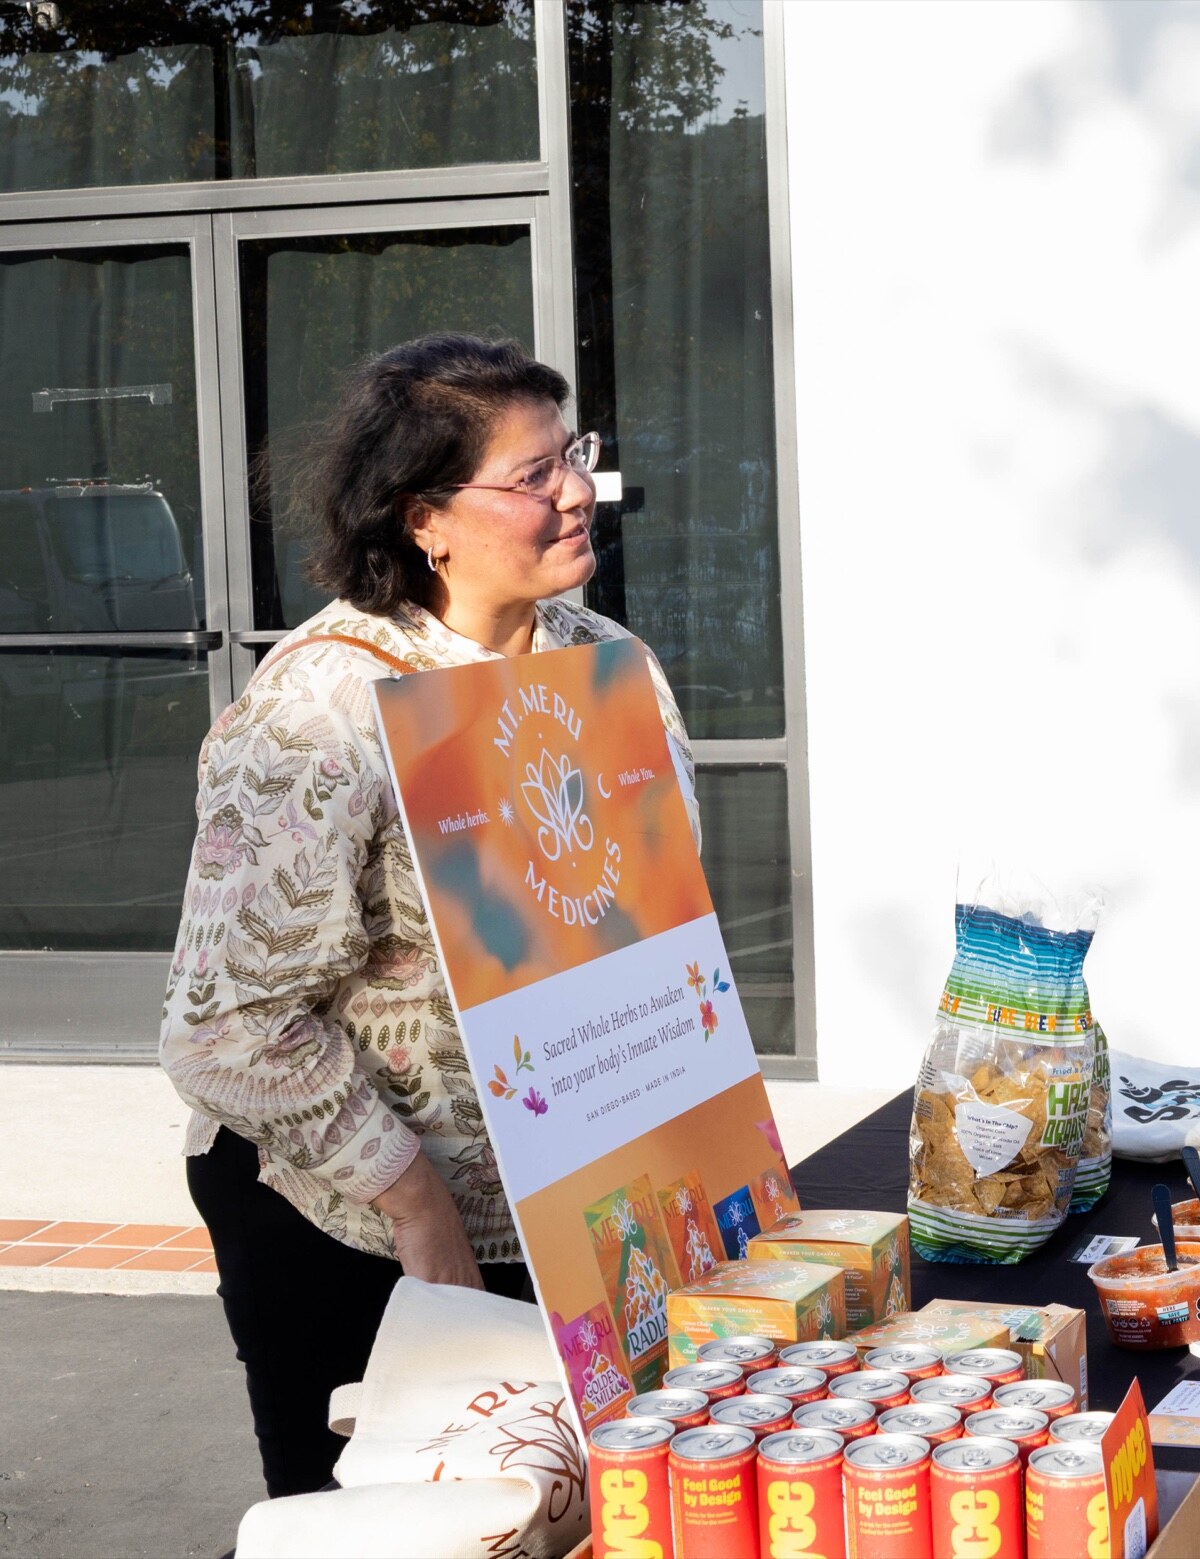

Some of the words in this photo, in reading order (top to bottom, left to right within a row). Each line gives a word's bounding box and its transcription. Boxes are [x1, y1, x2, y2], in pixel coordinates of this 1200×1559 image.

[518, 683, 582, 741] MERU
[618, 770, 640, 786] Whole
[438, 813, 466, 835] Whole
[466, 809, 491, 828] herbs.
[525, 837, 621, 927] MEDICINES
[543, 1028, 578, 1061] Sacred
[577, 1015, 611, 1044] Whole
[610, 1004, 638, 1030] Herbs
[638, 1002, 648, 1018] to
[650, 986, 685, 1013] Awaken
[551, 1076, 573, 1097] into
[574, 1064, 596, 1093] your
[596, 1045, 627, 1074] body's
[627, 1034, 658, 1061] Innate
[658, 1017, 695, 1044] Wisdom
[586, 1113, 599, 1121] SAN
[645, 1077, 661, 1092] MADE
[663, 1074, 669, 1082] IN
[670, 1066, 686, 1080] INDIA
[585, 1370, 619, 1399] GOLDEN
[593, 1389, 616, 1407] MILK
[683, 1477, 707, 1492] Feel
[709, 1474, 740, 1492] Good
[858, 1486, 882, 1501] Feel
[884, 1483, 916, 1501] Good
[684, 1491, 697, 1508] by
[700, 1491, 741, 1506] Design
[859, 1500, 872, 1519] by
[875, 1500, 917, 1516] Design
